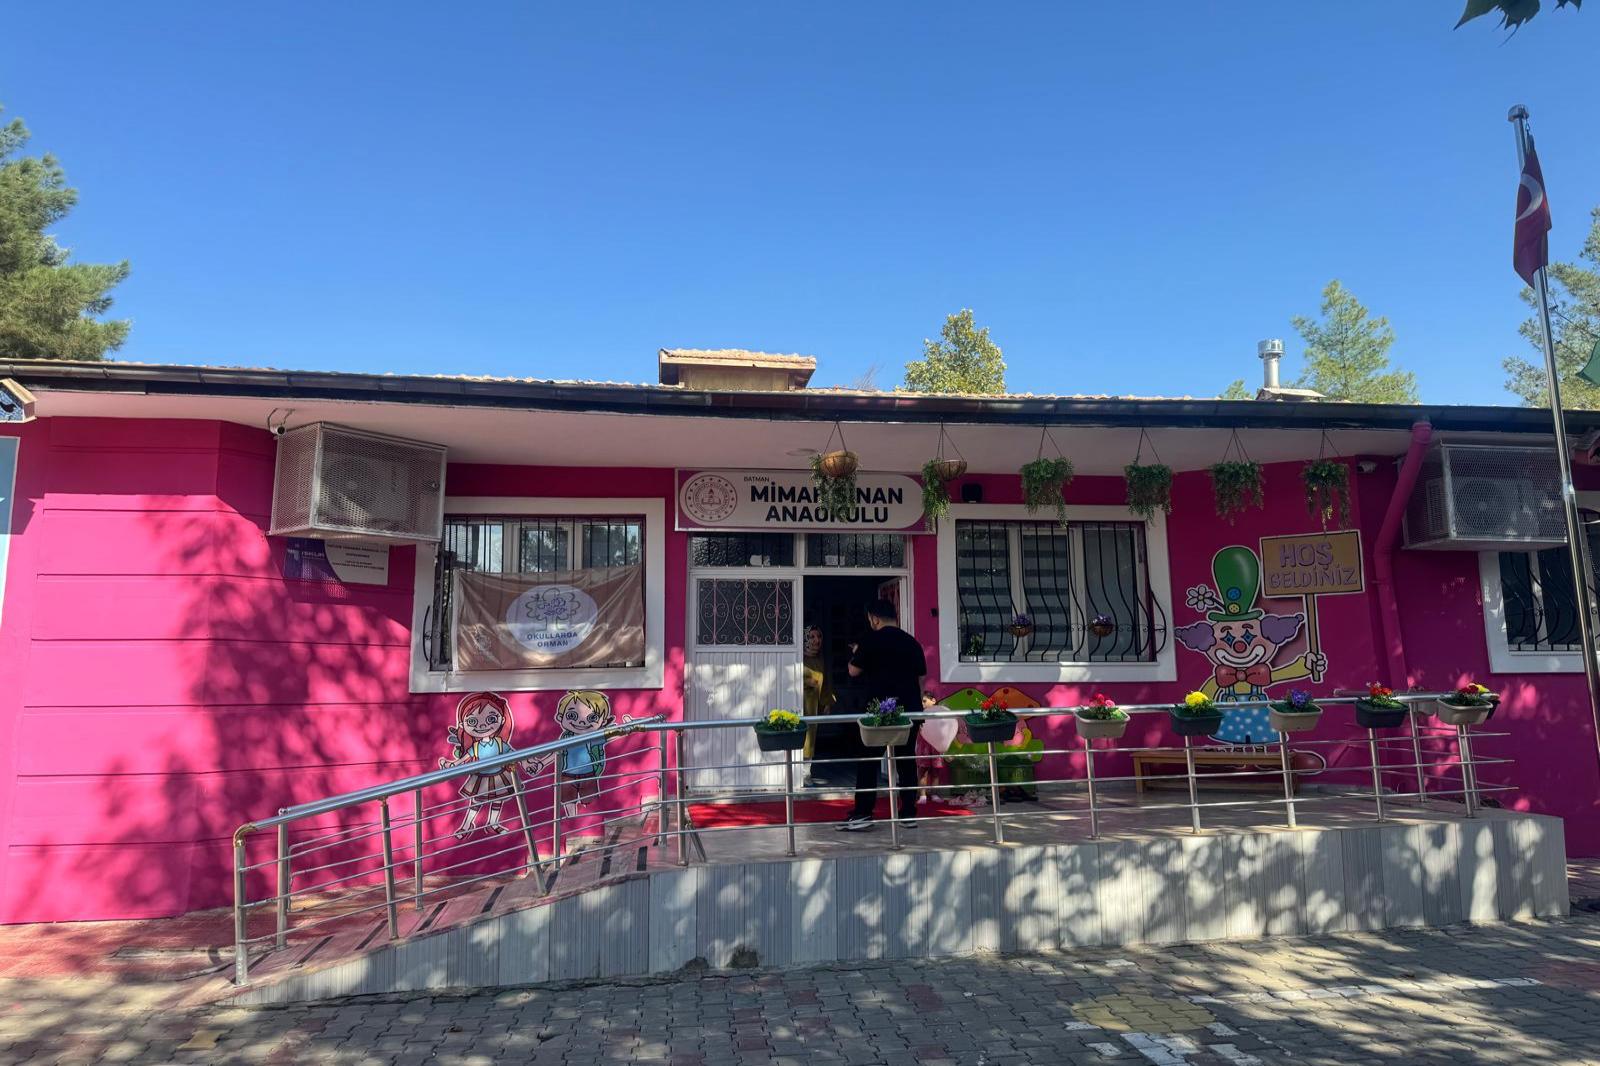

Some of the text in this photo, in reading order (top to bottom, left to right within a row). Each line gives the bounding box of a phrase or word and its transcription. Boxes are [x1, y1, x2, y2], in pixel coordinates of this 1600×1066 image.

[743, 475, 770, 483] BATMAN
[831, 483, 903, 504] NAN
[1280, 542, 1333, 570] HOŞ
[537, 640, 568, 648] ORMAN
